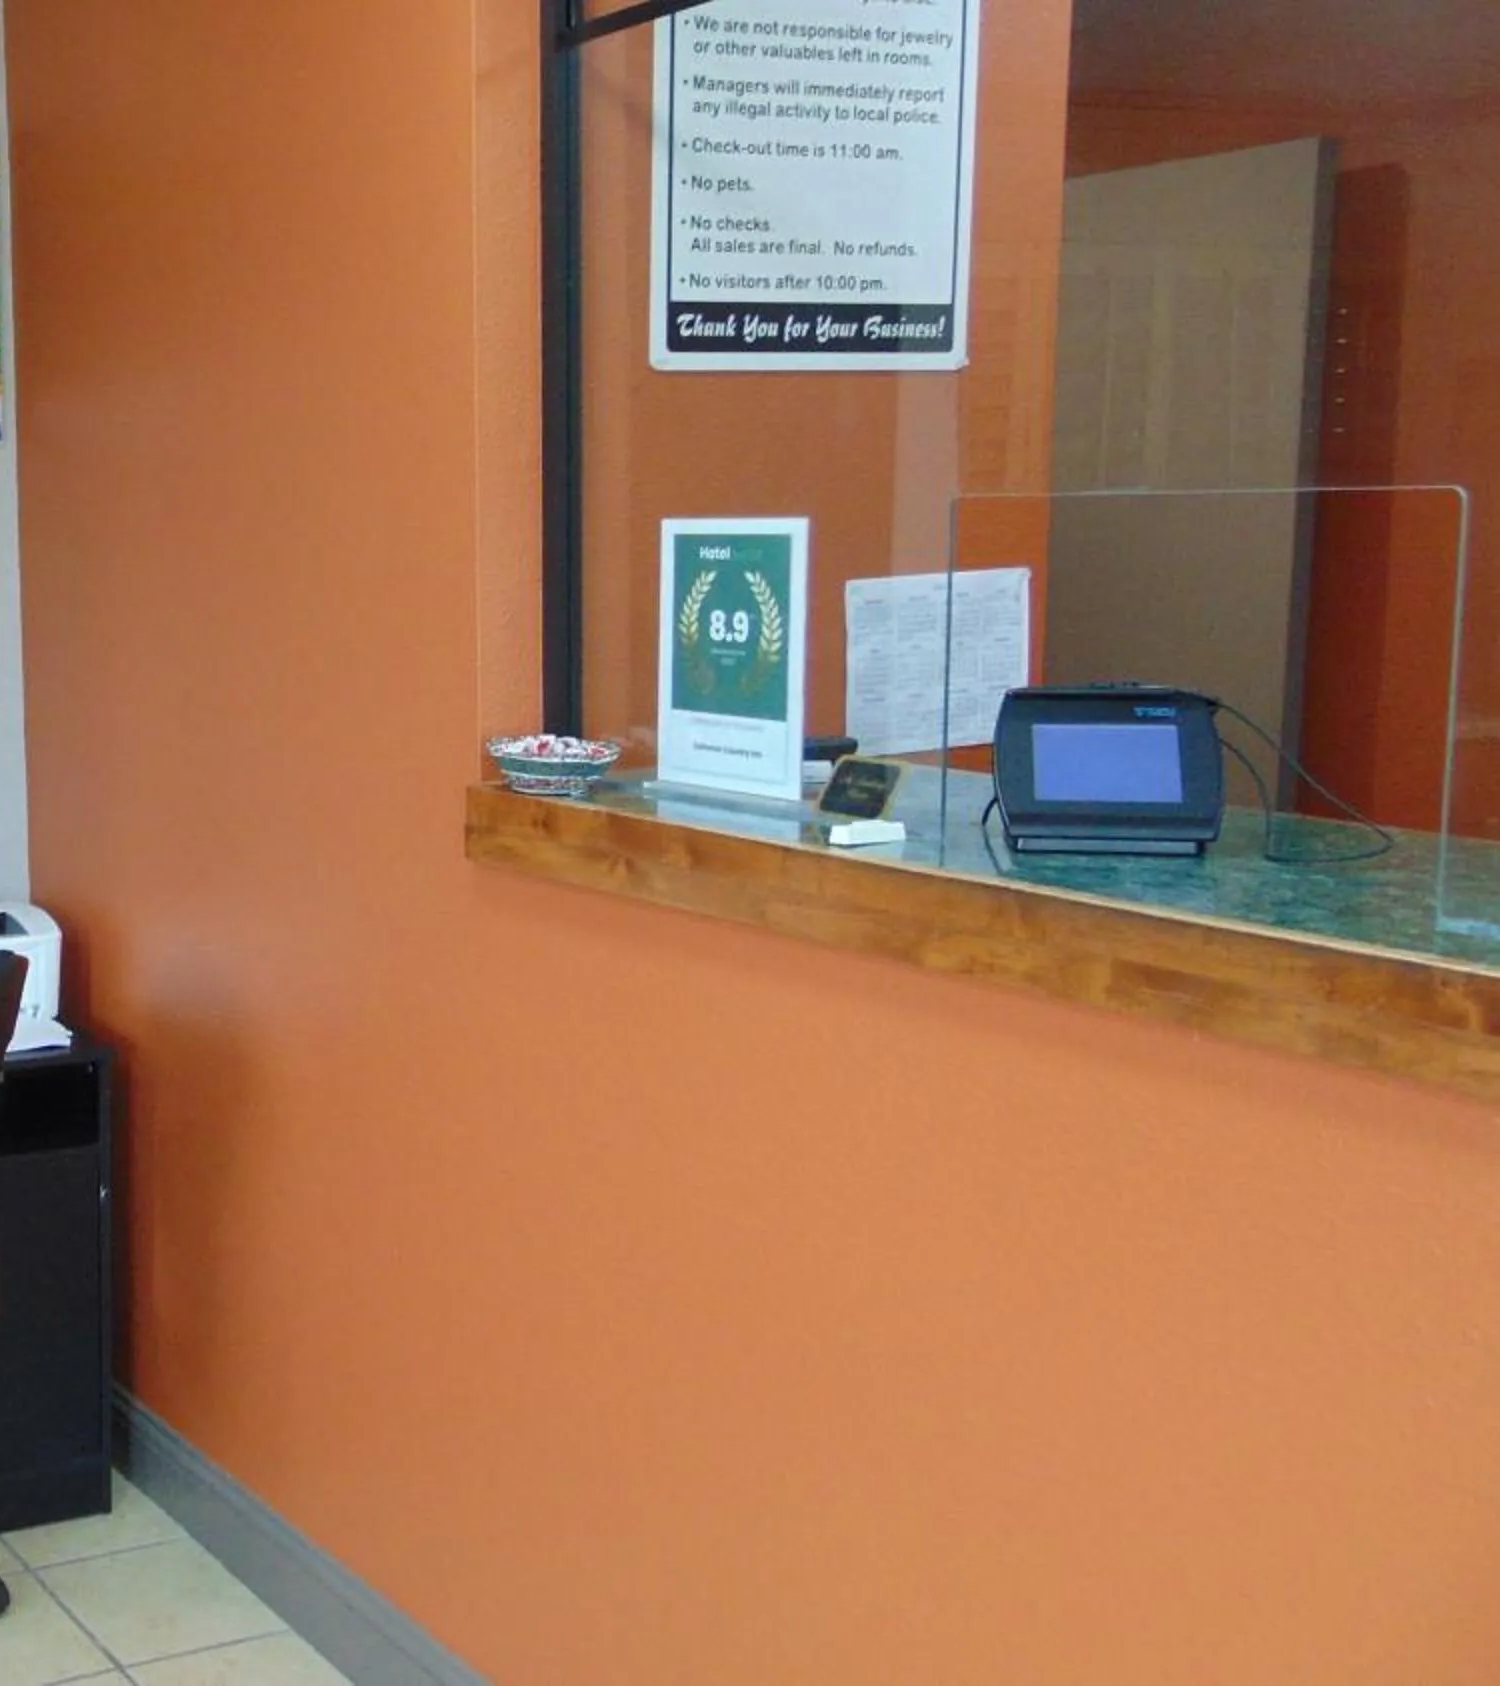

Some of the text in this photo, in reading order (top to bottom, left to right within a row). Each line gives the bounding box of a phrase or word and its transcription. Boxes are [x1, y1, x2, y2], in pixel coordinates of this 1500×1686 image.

[694, 15, 954, 49] We are not responsible for jewelry
[693, 40, 933, 67] or other valuables left in rooms.
[693, 75, 945, 104] Managers will immediately report
[692, 99, 941, 125] any illegal activity to local police.
[691, 136, 904, 162] Check-out time is 11:00 am.
[691, 175, 755, 194] No pets.
[690, 215, 712, 231] No
[691, 237, 711, 253] All
[715, 238, 755, 254] sales
[759, 241, 785, 255] are
[833, 241, 854, 256] No
[858, 240, 919, 258] refunds.
[689, 273, 888, 294] No visitors after 10:00 pm.
[676, 313, 946, 343] Thank You for Your Business!
[699, 546, 731, 560] Hotel
[709, 609, 749, 643] 8.9
